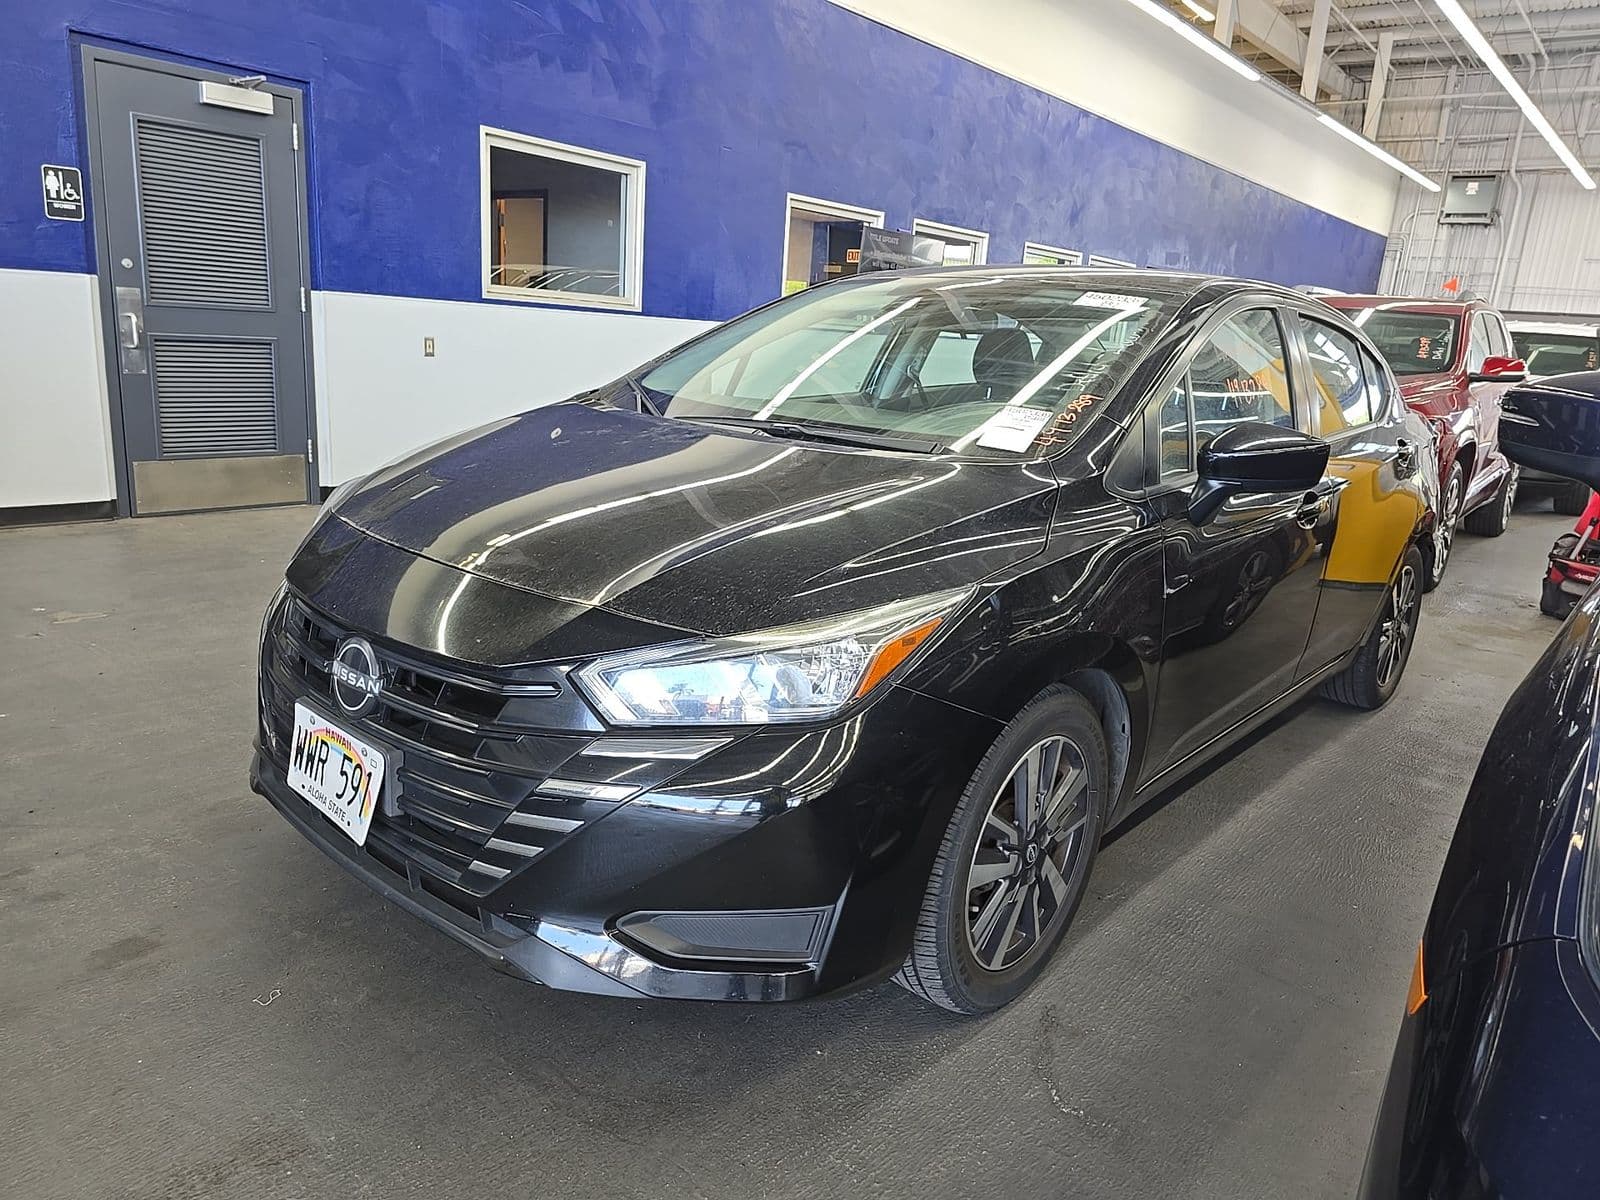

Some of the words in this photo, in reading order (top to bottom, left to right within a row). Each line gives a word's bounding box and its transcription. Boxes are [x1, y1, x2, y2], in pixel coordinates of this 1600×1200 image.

[332, 660, 380, 694] NISSAN
[325, 727, 352, 751] HAWAII
[294, 725, 331, 786] WWR
[335, 754, 373, 818] 591
[308, 785, 327, 806] ALOHA
[327, 800, 346, 823] STATE
